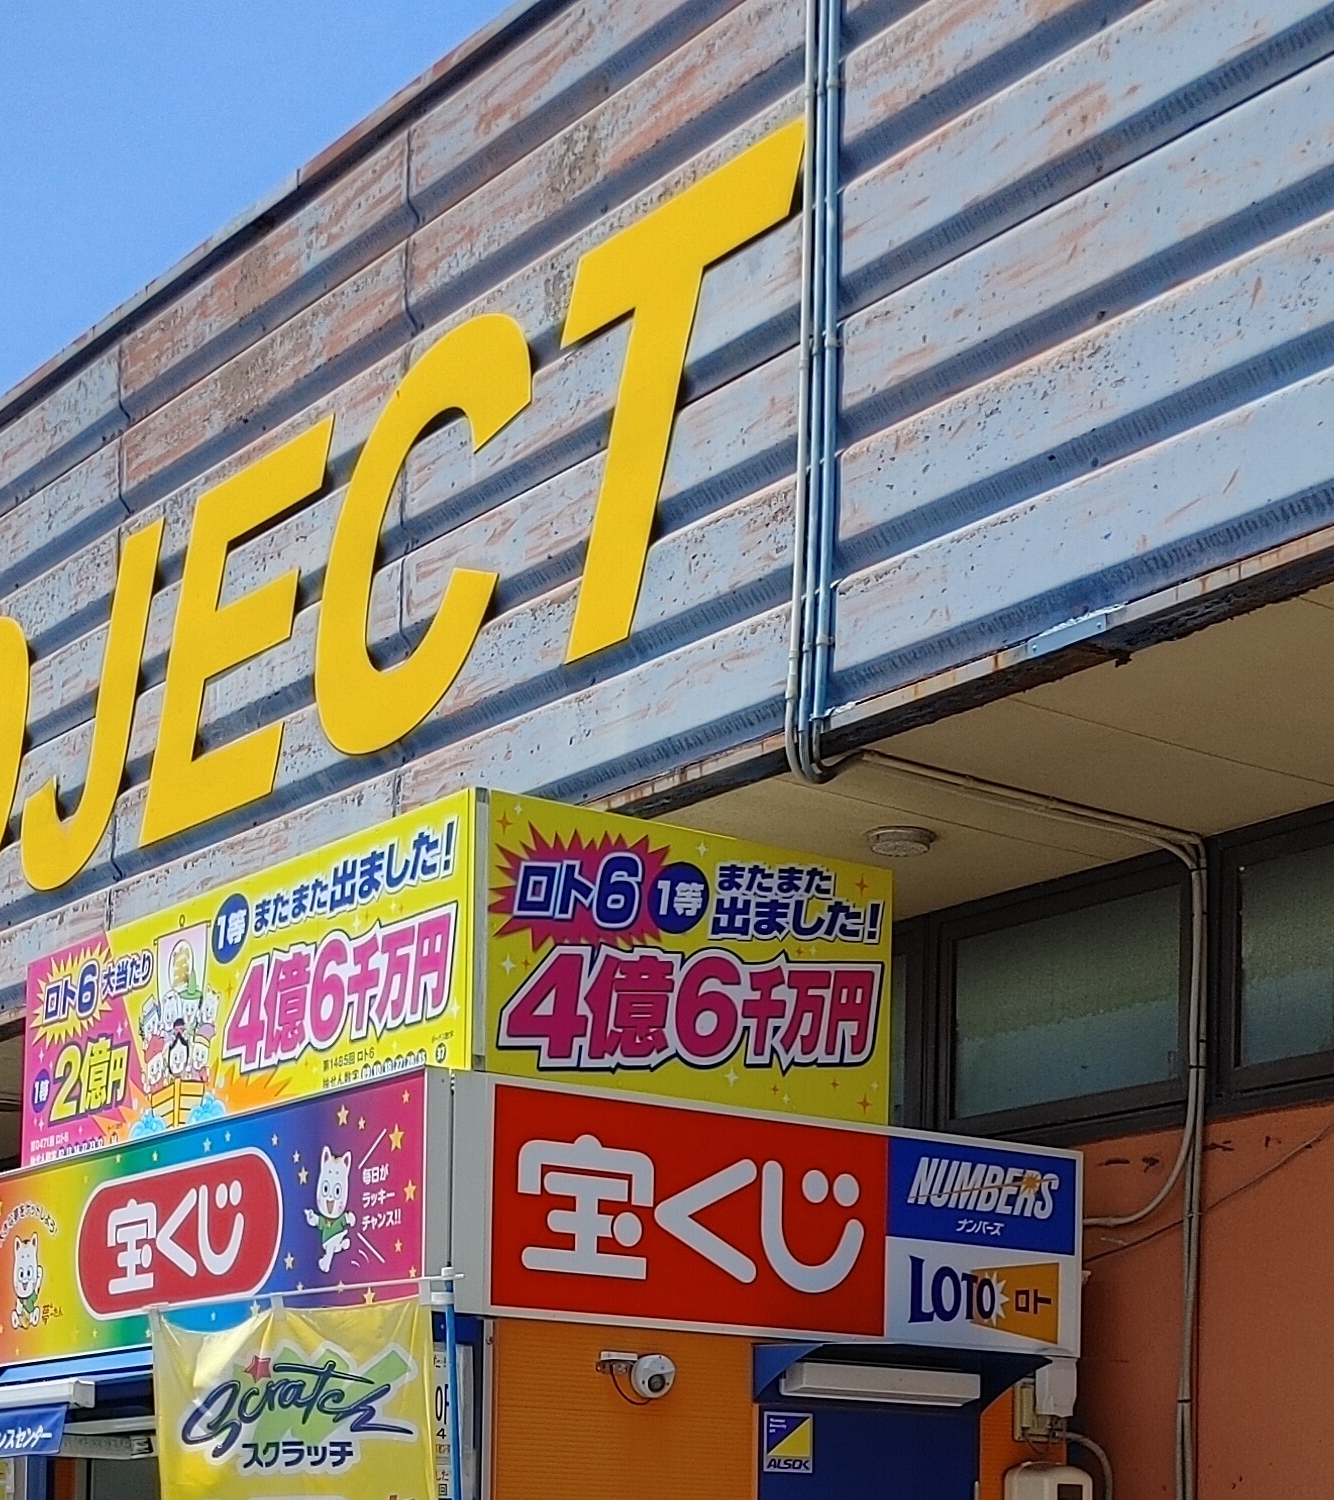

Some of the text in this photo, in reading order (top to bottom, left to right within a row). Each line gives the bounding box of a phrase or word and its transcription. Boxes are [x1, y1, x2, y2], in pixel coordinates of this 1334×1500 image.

[215, 816, 458, 951] 1等 またまた出ました!
[515, 851, 646, 930] ロト6
[656, 878, 705, 918] 1等
[717, 862, 835, 896] またまた
[710, 897, 883, 944] 出ました!
[43, 949, 154, 1021] ロト6 大当たり
[228, 911, 454, 1066] 4億6千万円
[502, 950, 880, 1066] 4億6千万円
[48, 1034, 131, 1122] 2億円
[357, 1047, 375, 1065] ロト6
[361, 1165, 389, 1185] 毎日が
[361, 1187, 396, 1209] ラッキー
[907, 1156, 1061, 1221] NUMBERS
[107, 1178, 245, 1295] 宝くじ
[361, 1208, 402, 1232] チャンス!!
[517, 1133, 865, 1294] 宝くじ
[955, 1218, 1006, 1238] ナンバーズ
[907, 1255, 998, 1325] LOTO
[241, 1440, 355, 1470] スクラッチ
[767, 1458, 810, 1471] ALSOK
